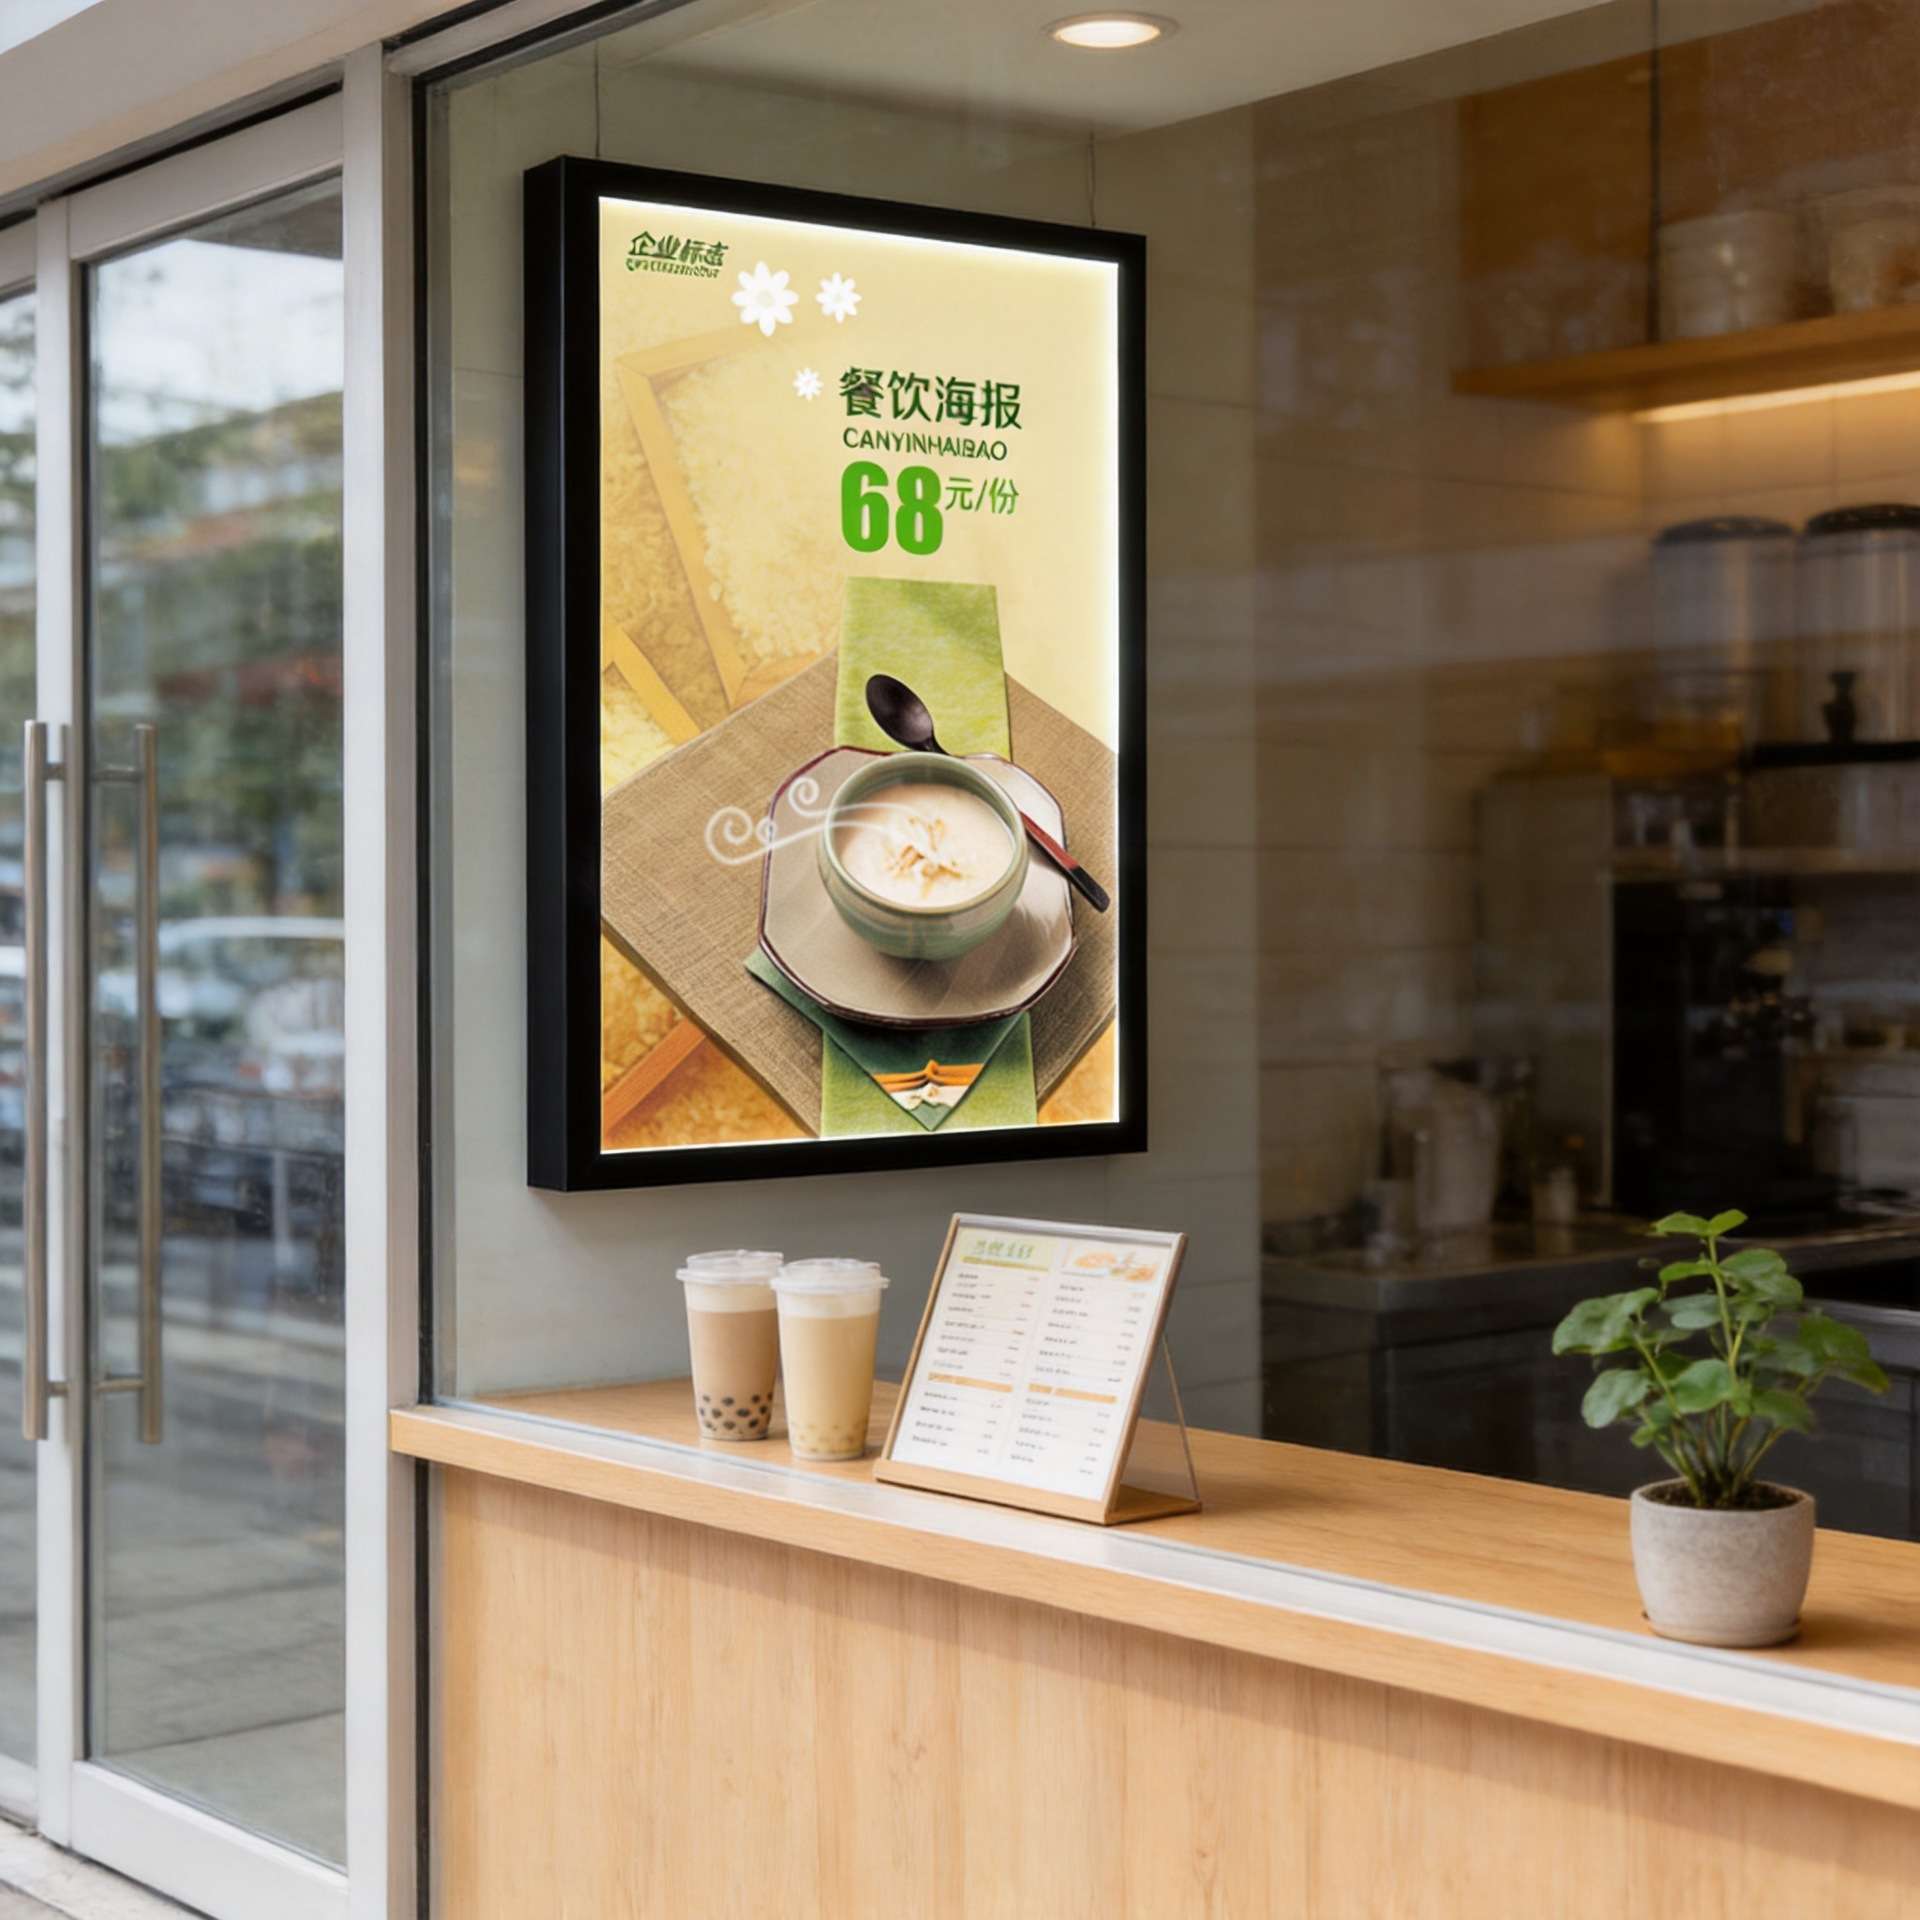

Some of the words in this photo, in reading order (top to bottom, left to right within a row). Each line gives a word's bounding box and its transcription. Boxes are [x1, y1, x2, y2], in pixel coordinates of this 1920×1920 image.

[840, 366, 1022, 430] 餐饮海报
[843, 427, 1008, 461] CANYINHAIBAO
[841, 461, 944, 555] 68
[945, 476, 1019, 515] 元/份
